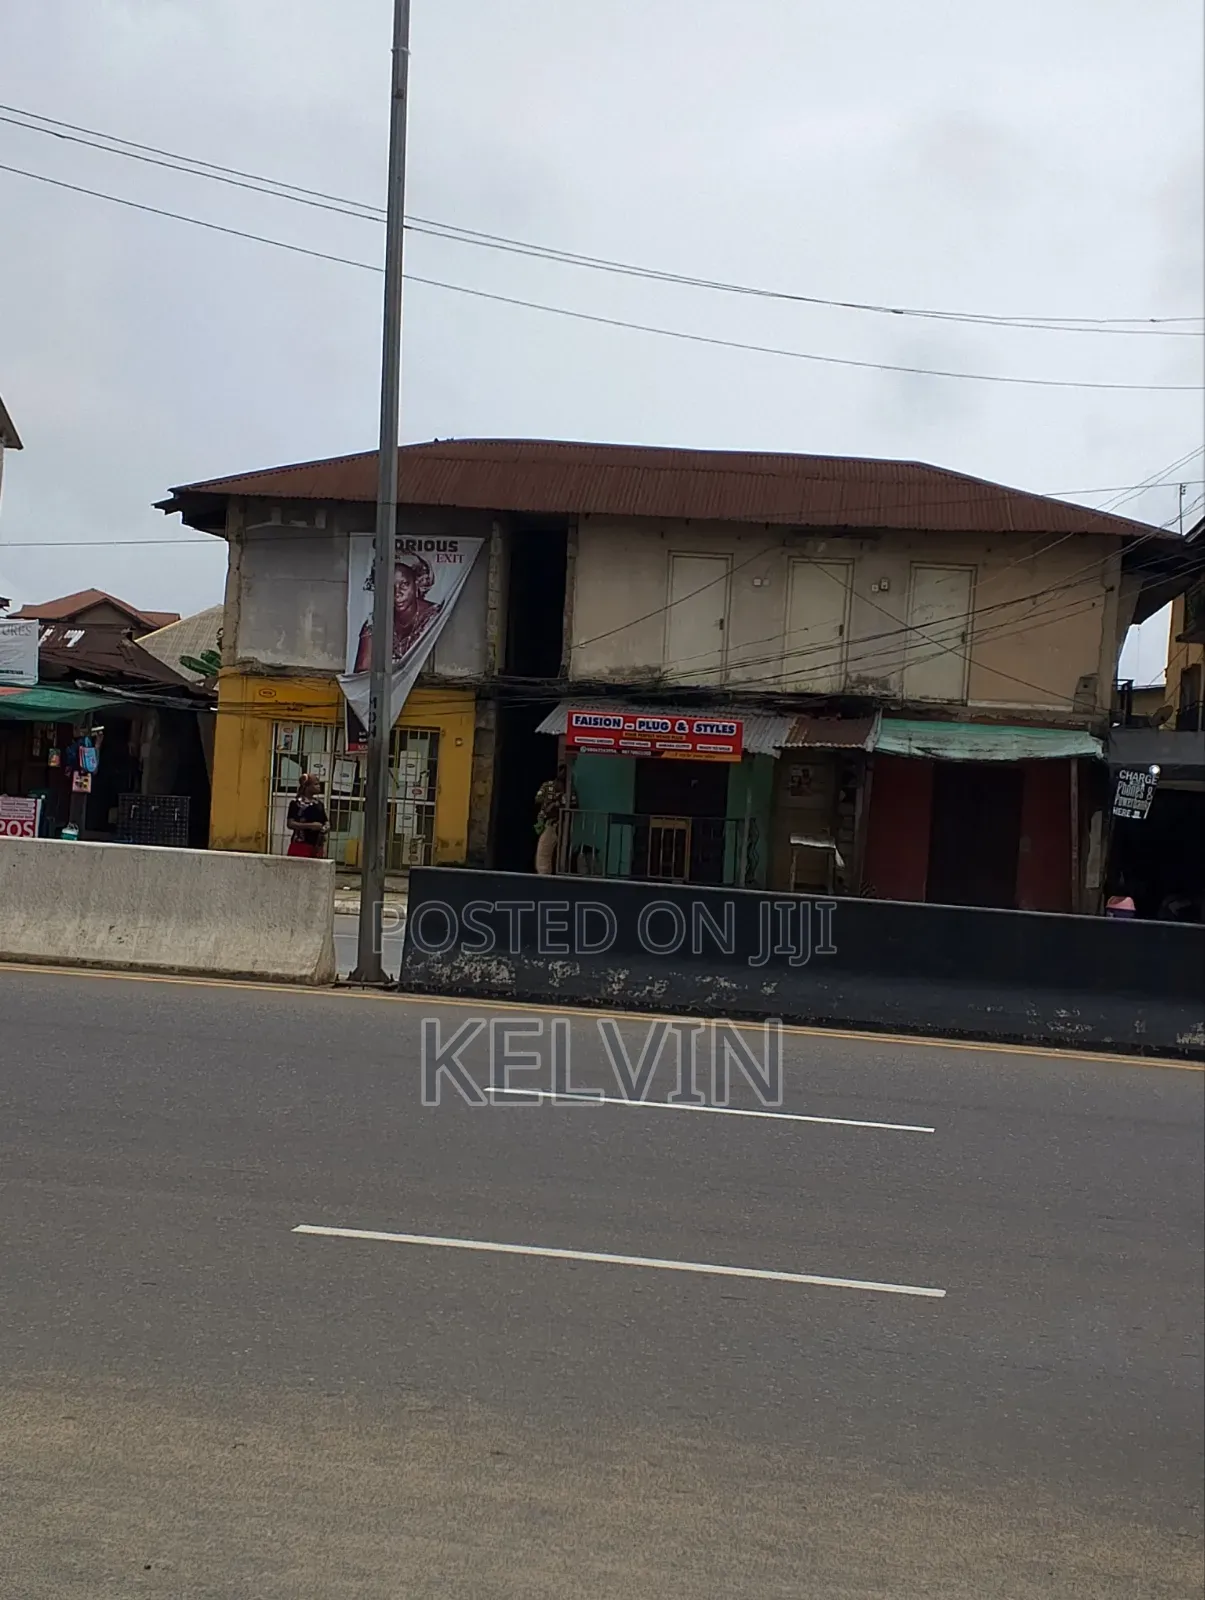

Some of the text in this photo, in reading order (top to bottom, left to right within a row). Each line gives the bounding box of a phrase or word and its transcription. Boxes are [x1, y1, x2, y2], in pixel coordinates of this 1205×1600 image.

[436, 553, 465, 563] EXIT
[574, 715, 622, 728] FAISION
[638, 720, 669, 732] PLUG
[677, 721, 687, 732] &
[695, 723, 735, 734] STYLES
[1119, 770, 1159, 785] CHARGE
